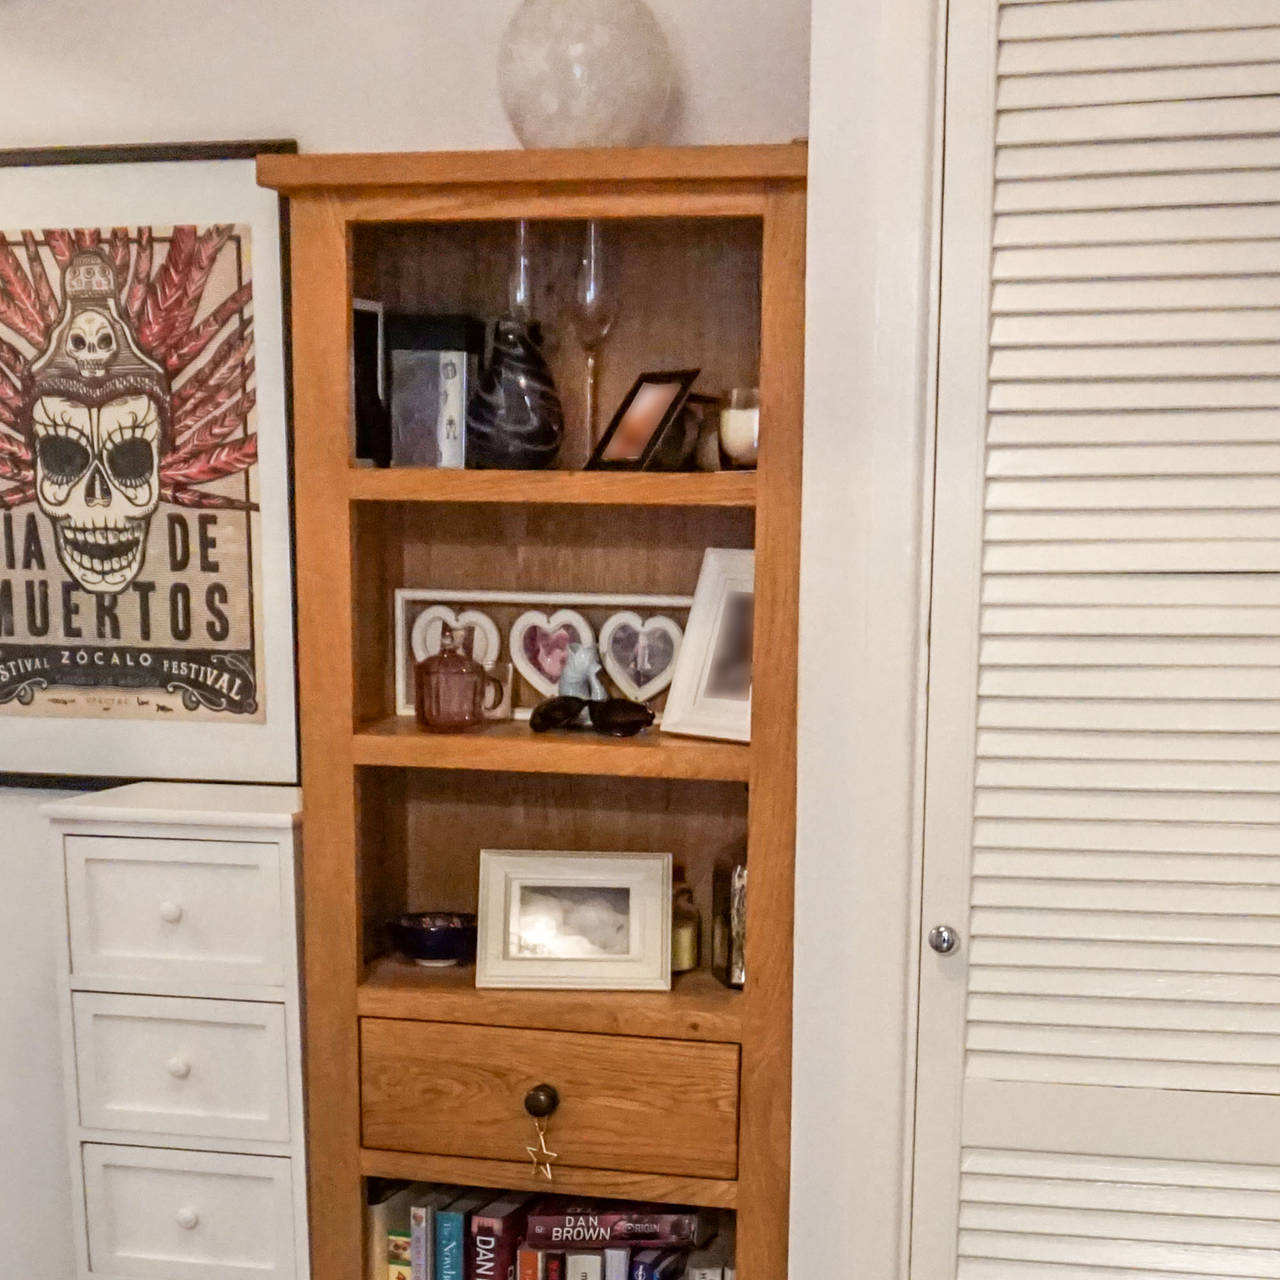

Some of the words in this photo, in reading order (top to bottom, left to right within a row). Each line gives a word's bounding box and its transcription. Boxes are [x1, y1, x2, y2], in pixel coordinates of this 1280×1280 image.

[167, 512, 219, 573] DE
[61, 648, 152, 666] ZÓCALO
[163, 660, 242, 700] FESTIVAL
[552, 1227, 610, 1241] BROWN
[565, 1216, 598, 1227] DAN
[625, 1222, 660, 1234] ORIGIN
[475, 1236, 495, 1275] DAN
